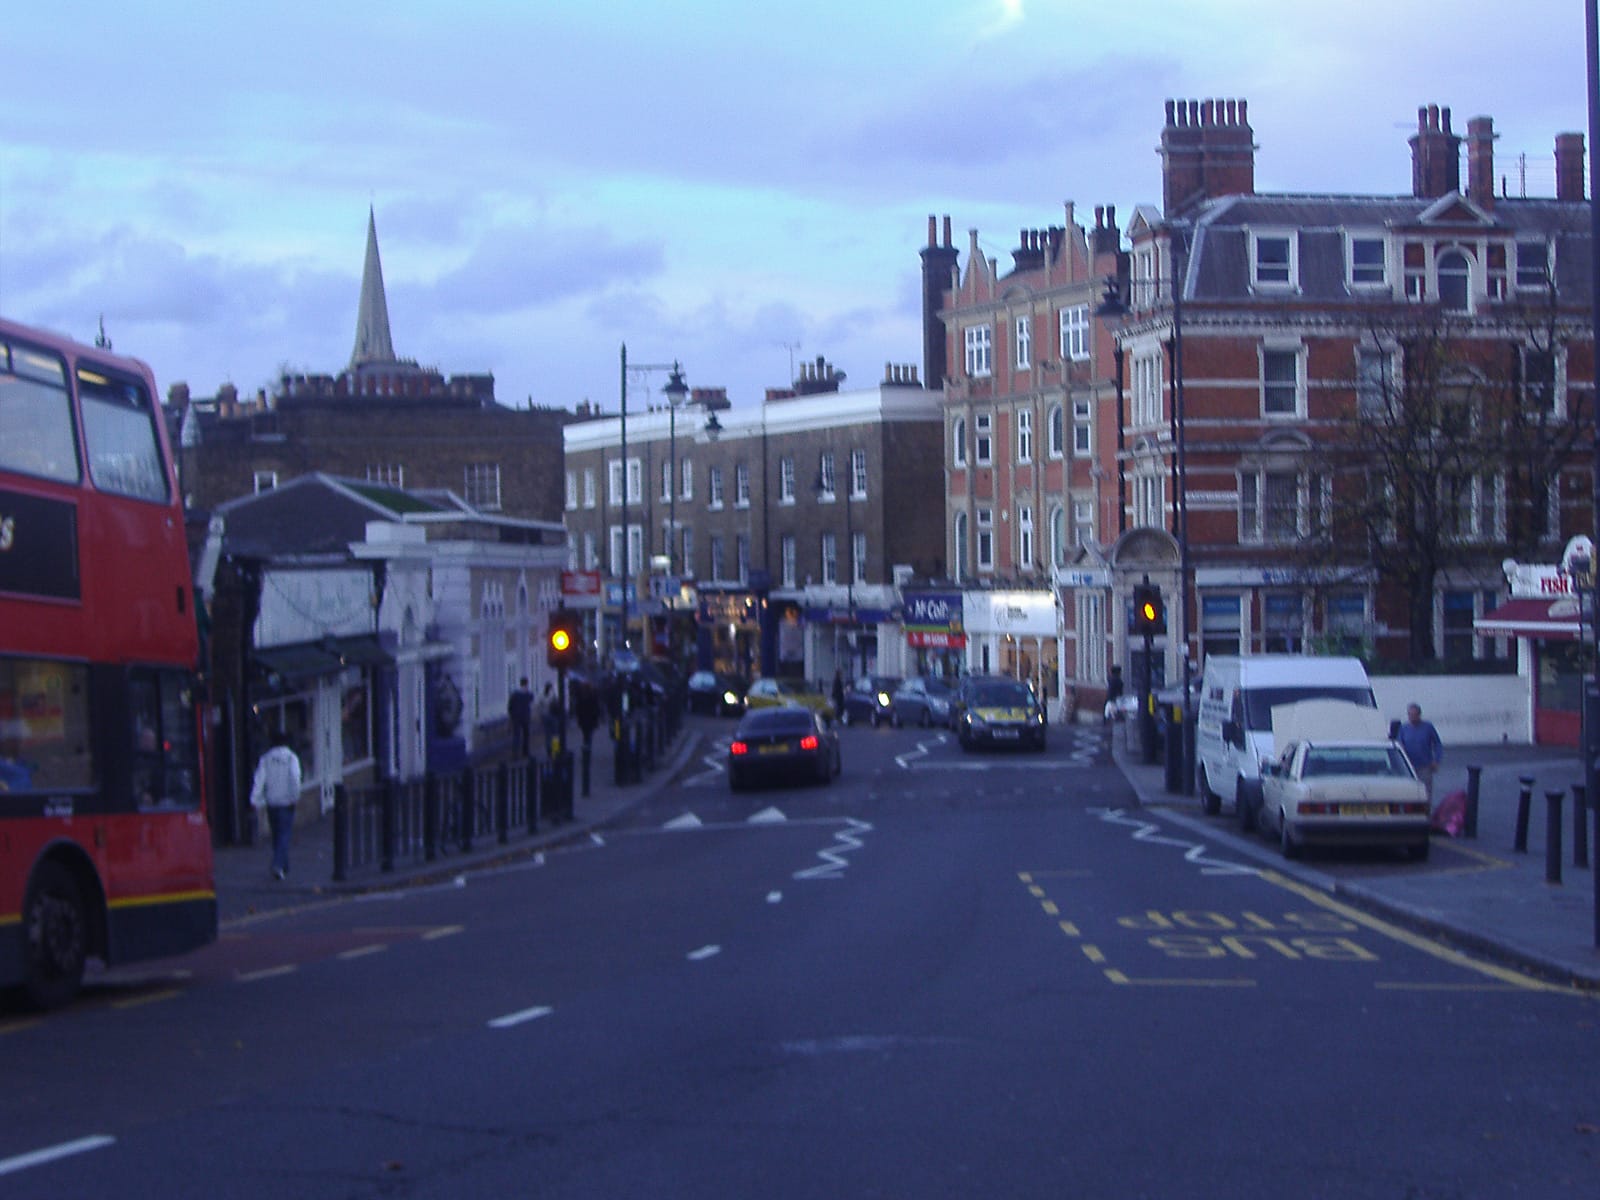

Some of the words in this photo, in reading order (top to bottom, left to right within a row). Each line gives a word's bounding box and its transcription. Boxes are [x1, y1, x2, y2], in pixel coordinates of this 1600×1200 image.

[1541, 576, 1568, 593] FISH
[1117, 910, 1359, 932] STOP
[1148, 936, 1380, 960] BUS
